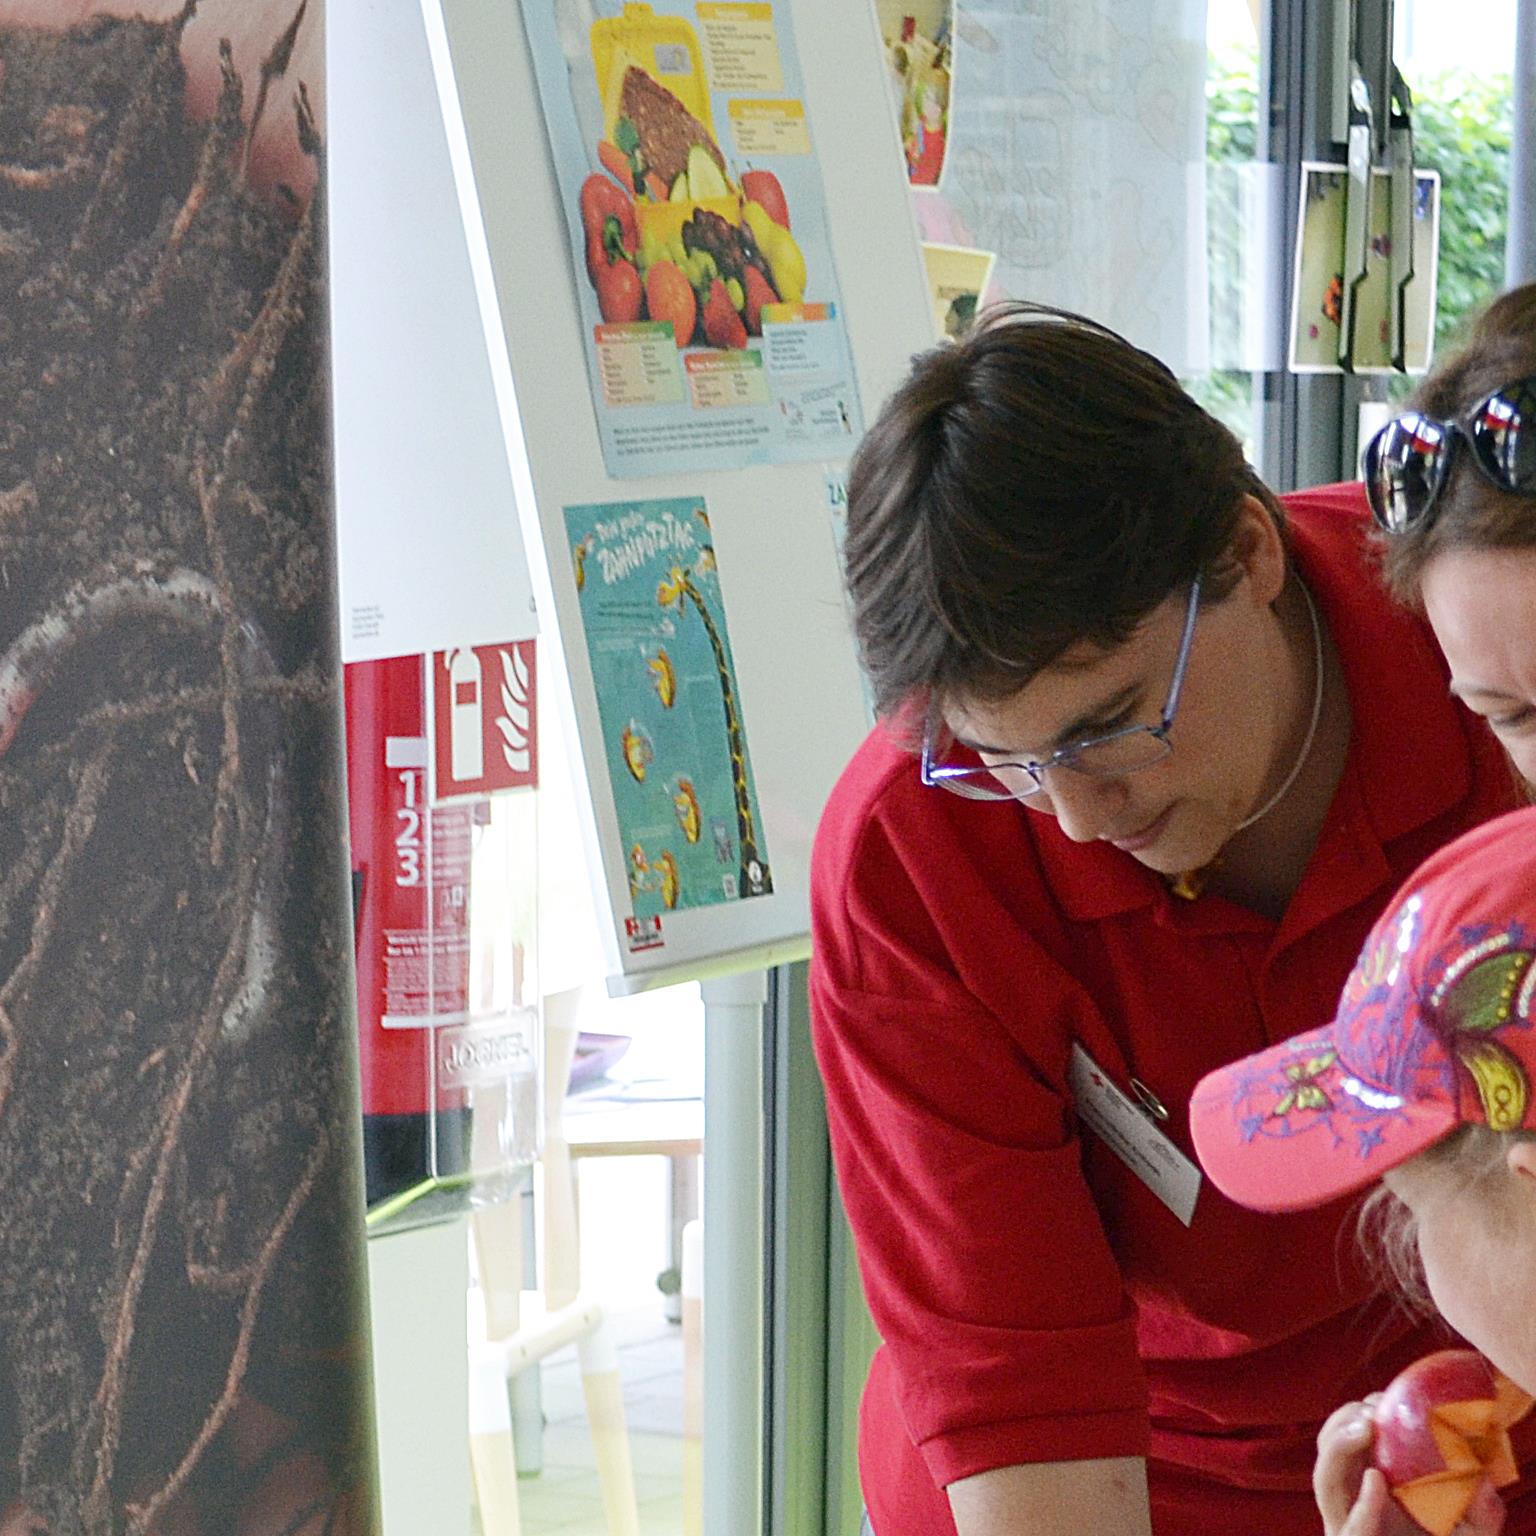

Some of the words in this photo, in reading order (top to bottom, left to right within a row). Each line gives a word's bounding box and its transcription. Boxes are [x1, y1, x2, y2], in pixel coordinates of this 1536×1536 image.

[398, 769, 416, 808] 1
[395, 808, 419, 847] 2
[395, 848, 419, 886] 3
